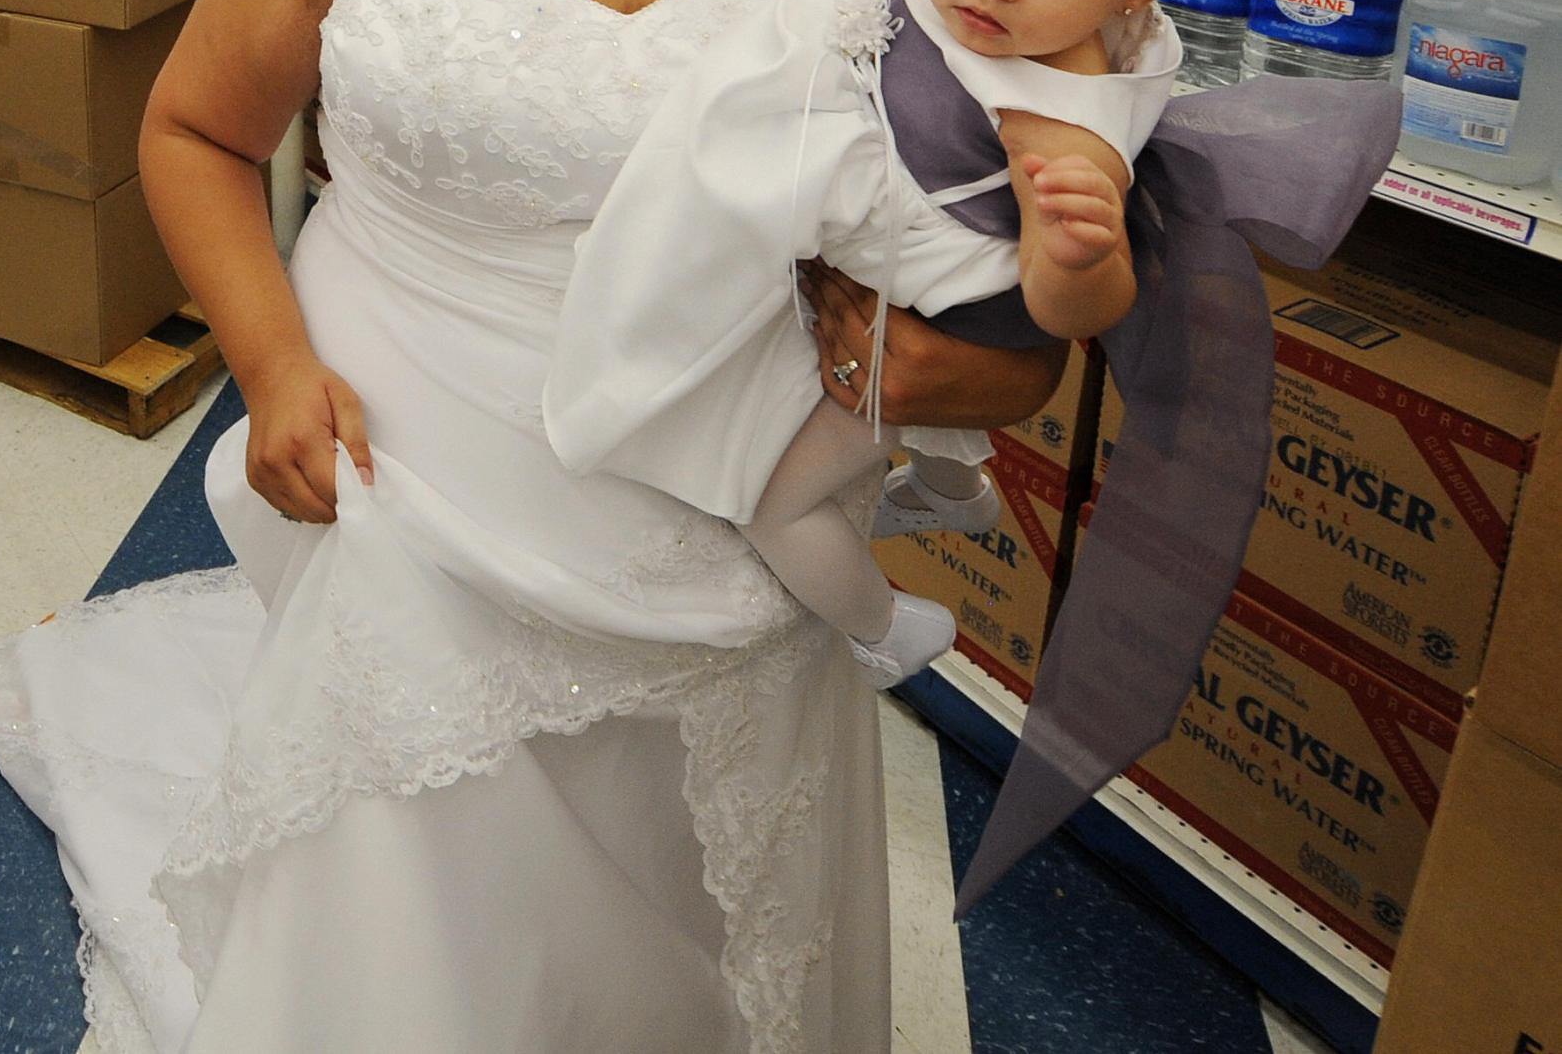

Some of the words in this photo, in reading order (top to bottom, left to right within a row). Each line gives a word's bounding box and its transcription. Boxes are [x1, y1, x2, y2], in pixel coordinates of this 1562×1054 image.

[1307, 16, 1335, 26] WATER
[1417, 38, 1506, 80] niagara
[1382, 175, 1407, 193] added
[1408, 185, 1419, 197] on
[1420, 188, 1431, 202] all
[1431, 192, 1475, 216] applicable
[1475, 207, 1525, 232] beverages.
[1305, 351, 1353, 385] THE
[1376, 384, 1496, 449] SOURCE
[1276, 434, 1437, 544] GEYSER
[1451, 473, 1489, 524] BOTTLES
[1329, 664, 1437, 733] SOURCE
[1180, 716, 1265, 786] SPRING
[1235, 694, 1387, 817] GEYSER
